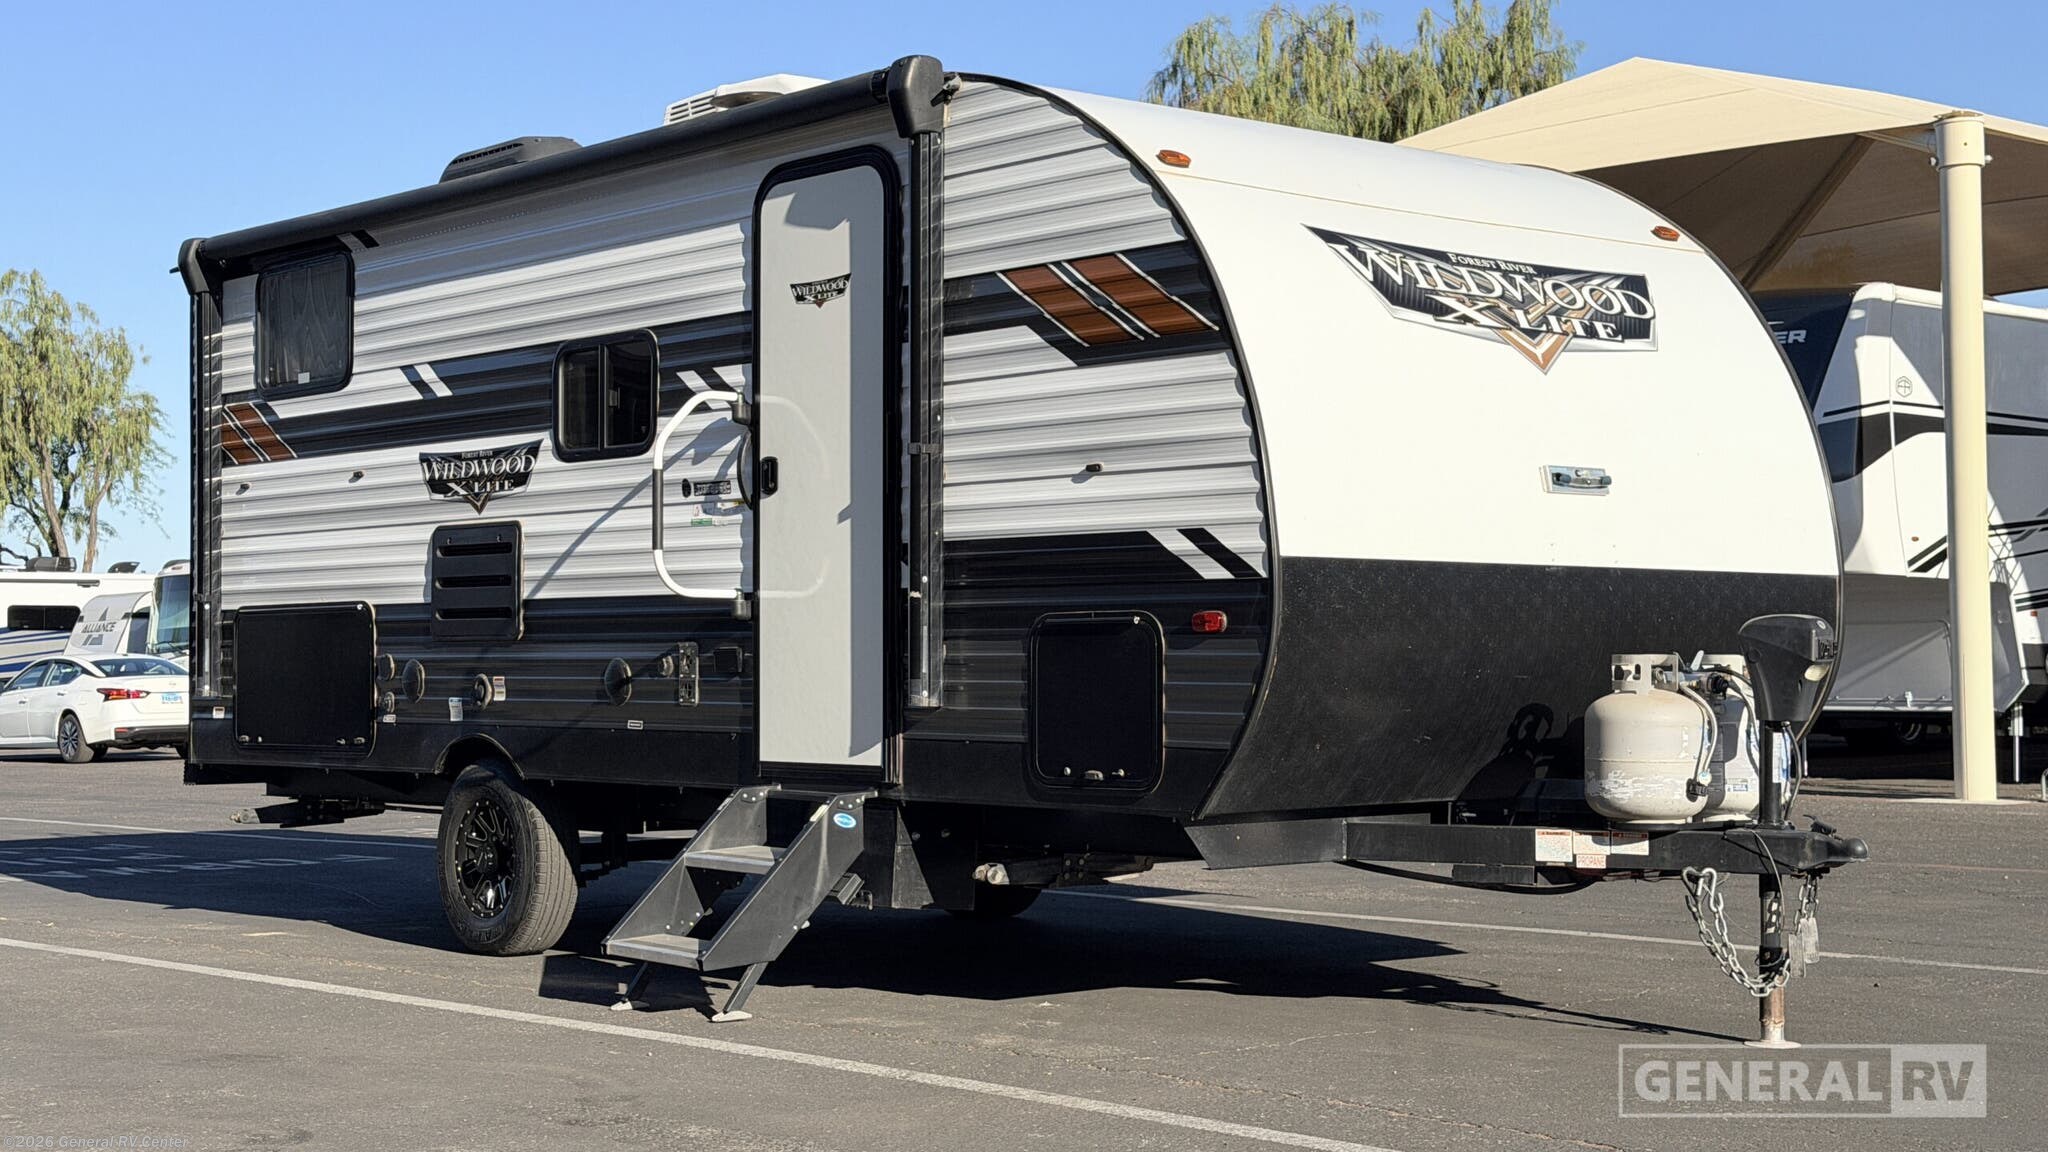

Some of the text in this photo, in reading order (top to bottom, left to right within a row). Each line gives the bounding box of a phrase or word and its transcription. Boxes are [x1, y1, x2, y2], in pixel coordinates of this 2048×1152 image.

[1446, 252, 1538, 275] FOREST RIVER
[792, 277, 849, 296] WILDWOOD
[1328, 243, 1656, 320] WILDWOOD
[1424, 293, 1625, 343] X LITE
[422, 454, 536, 481] WILDWOOD
[444, 479, 515, 498] X LITE
[81, 621, 117, 633] ALLIANCE
